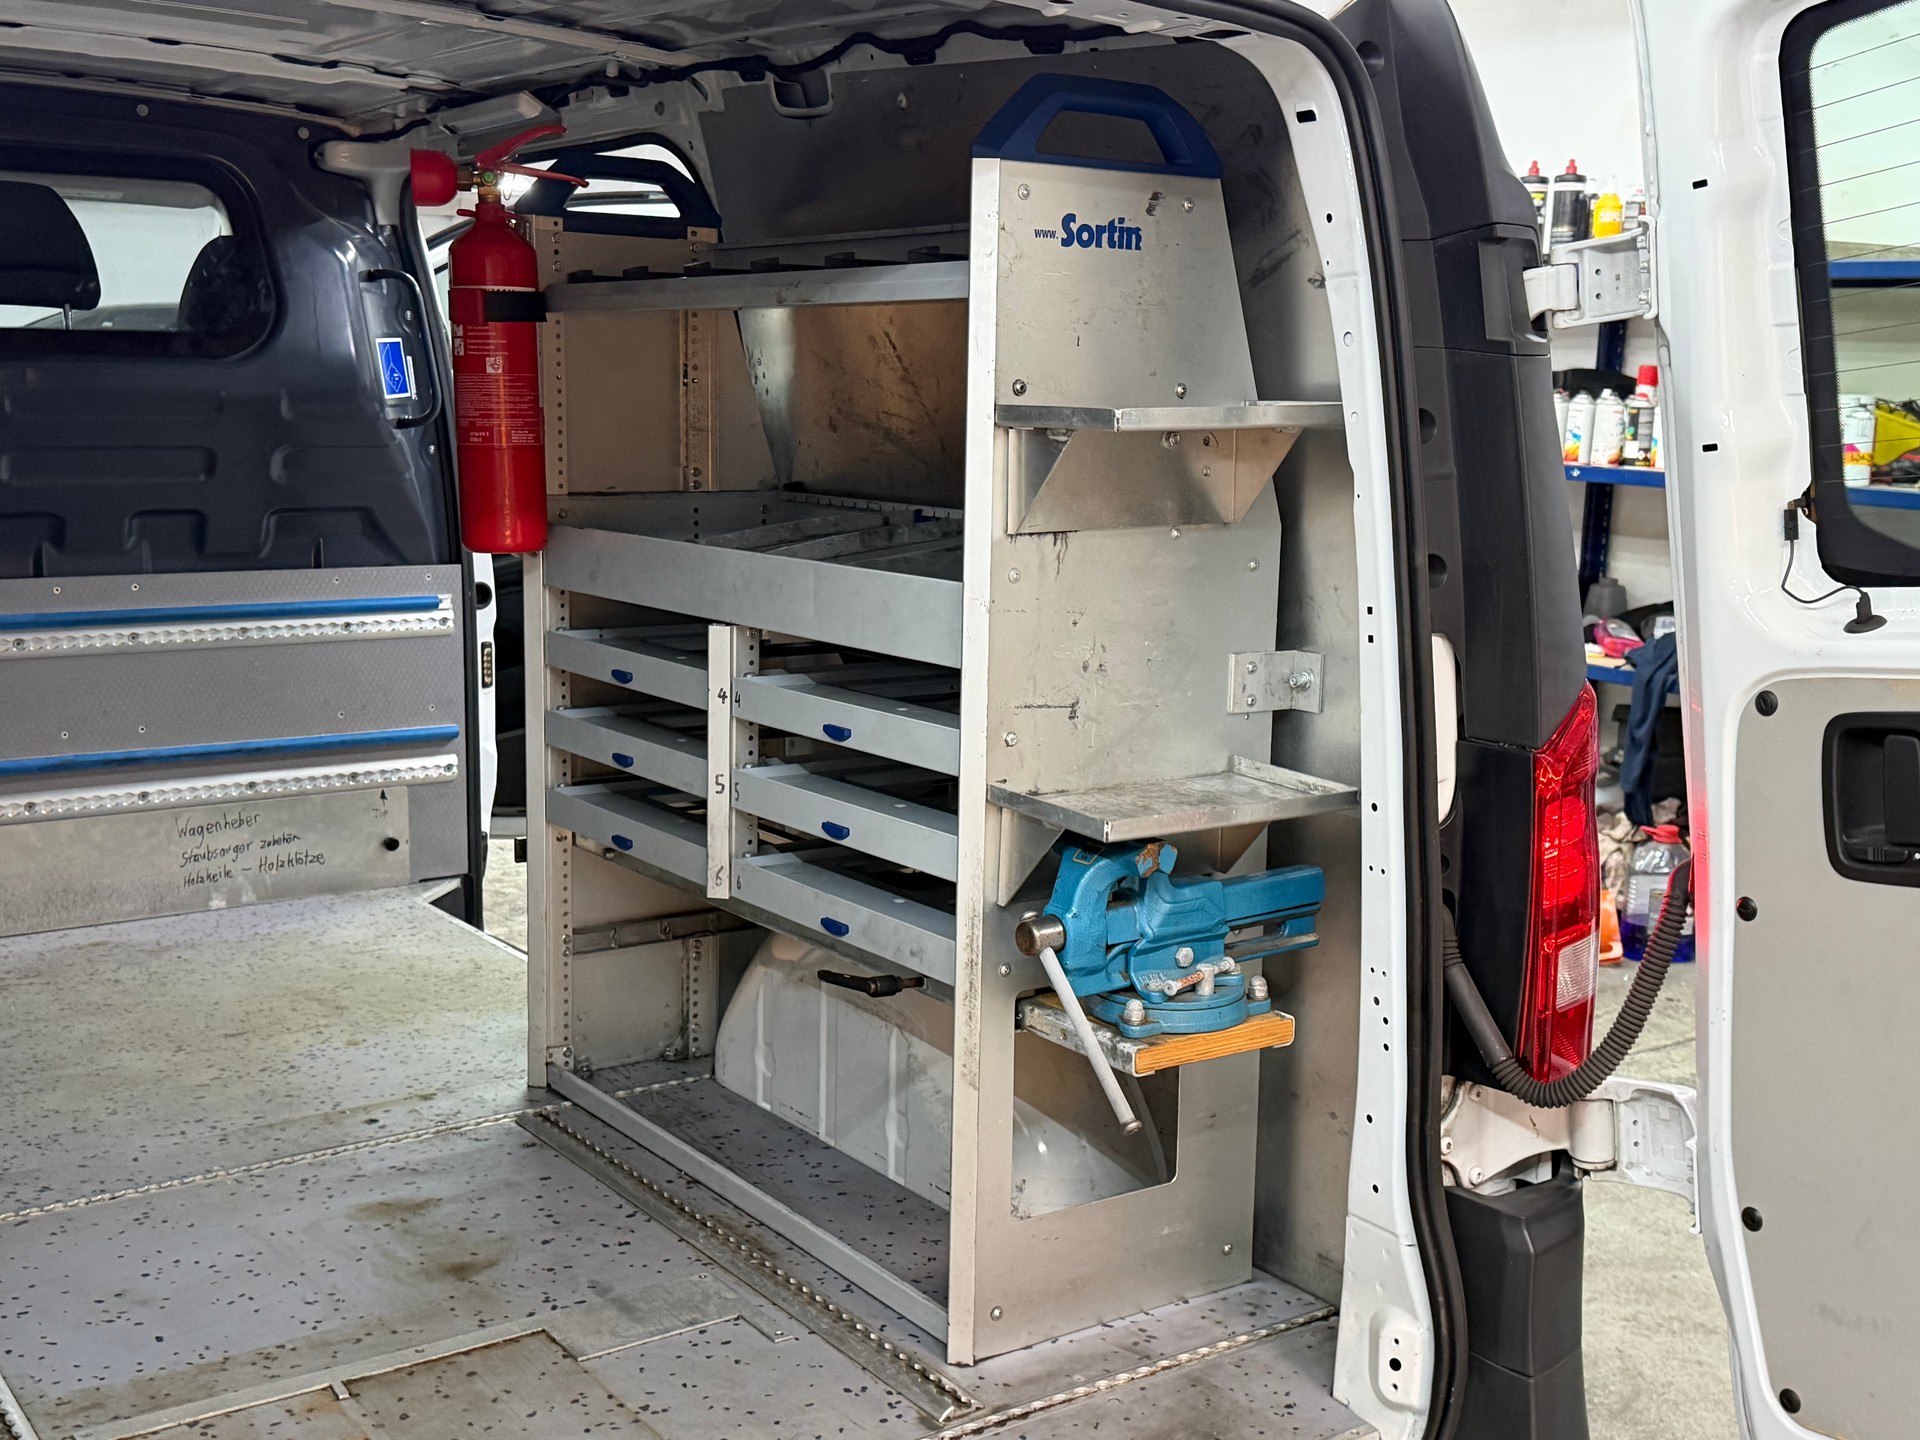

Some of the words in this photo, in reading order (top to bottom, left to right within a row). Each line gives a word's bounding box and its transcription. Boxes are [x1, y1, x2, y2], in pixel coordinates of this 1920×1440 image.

[717, 687, 728, 705] 4
[734, 690, 741, 708] 4
[715, 773, 726, 795] 5
[734, 781, 740, 802] 5
[175, 811, 261, 849] Wagenheber
[183, 864, 234, 889] Holzkeile
[715, 864, 724, 887] 6
[736, 875, 742, 890] 6
